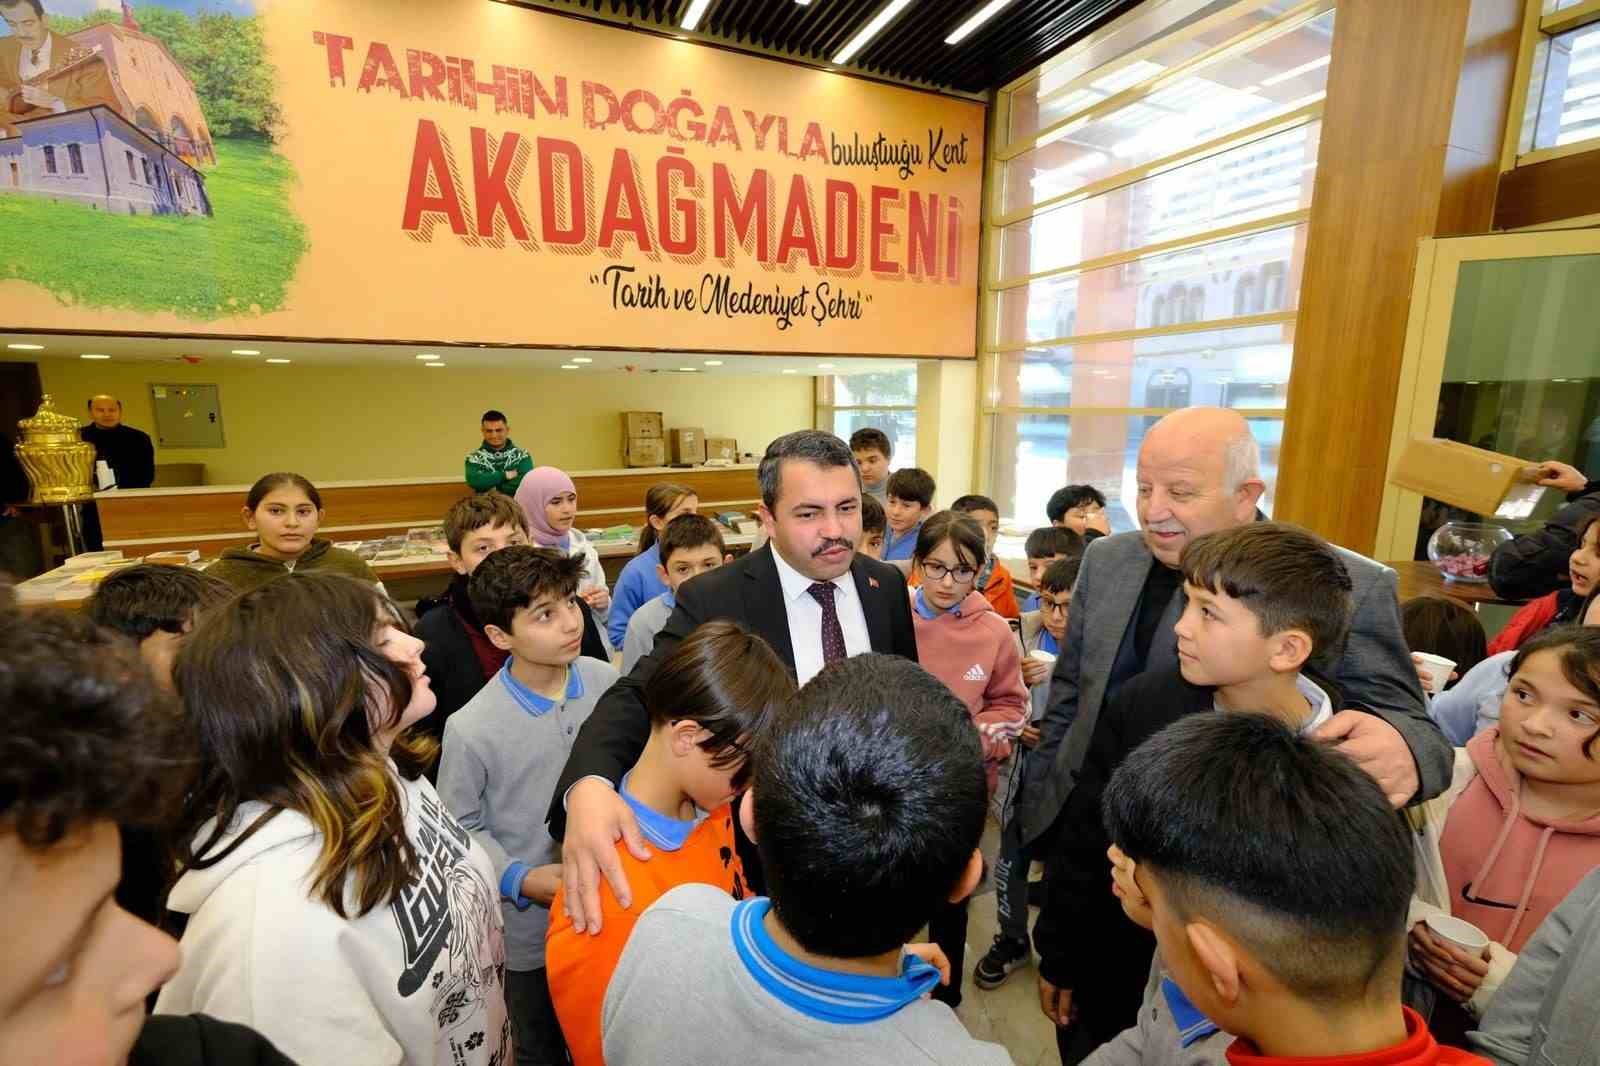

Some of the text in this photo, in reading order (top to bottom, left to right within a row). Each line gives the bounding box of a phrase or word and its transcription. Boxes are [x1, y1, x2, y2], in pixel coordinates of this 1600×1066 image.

[312, 30, 569, 120] TARİHİN
[582, 81, 830, 165] DOĞAYLA
[928, 127, 969, 172] Kent
[401, 118, 961, 285] AKDAĞMADENİ
[674, 287, 696, 311] ve
[700, 273, 809, 330] Medeniyet
